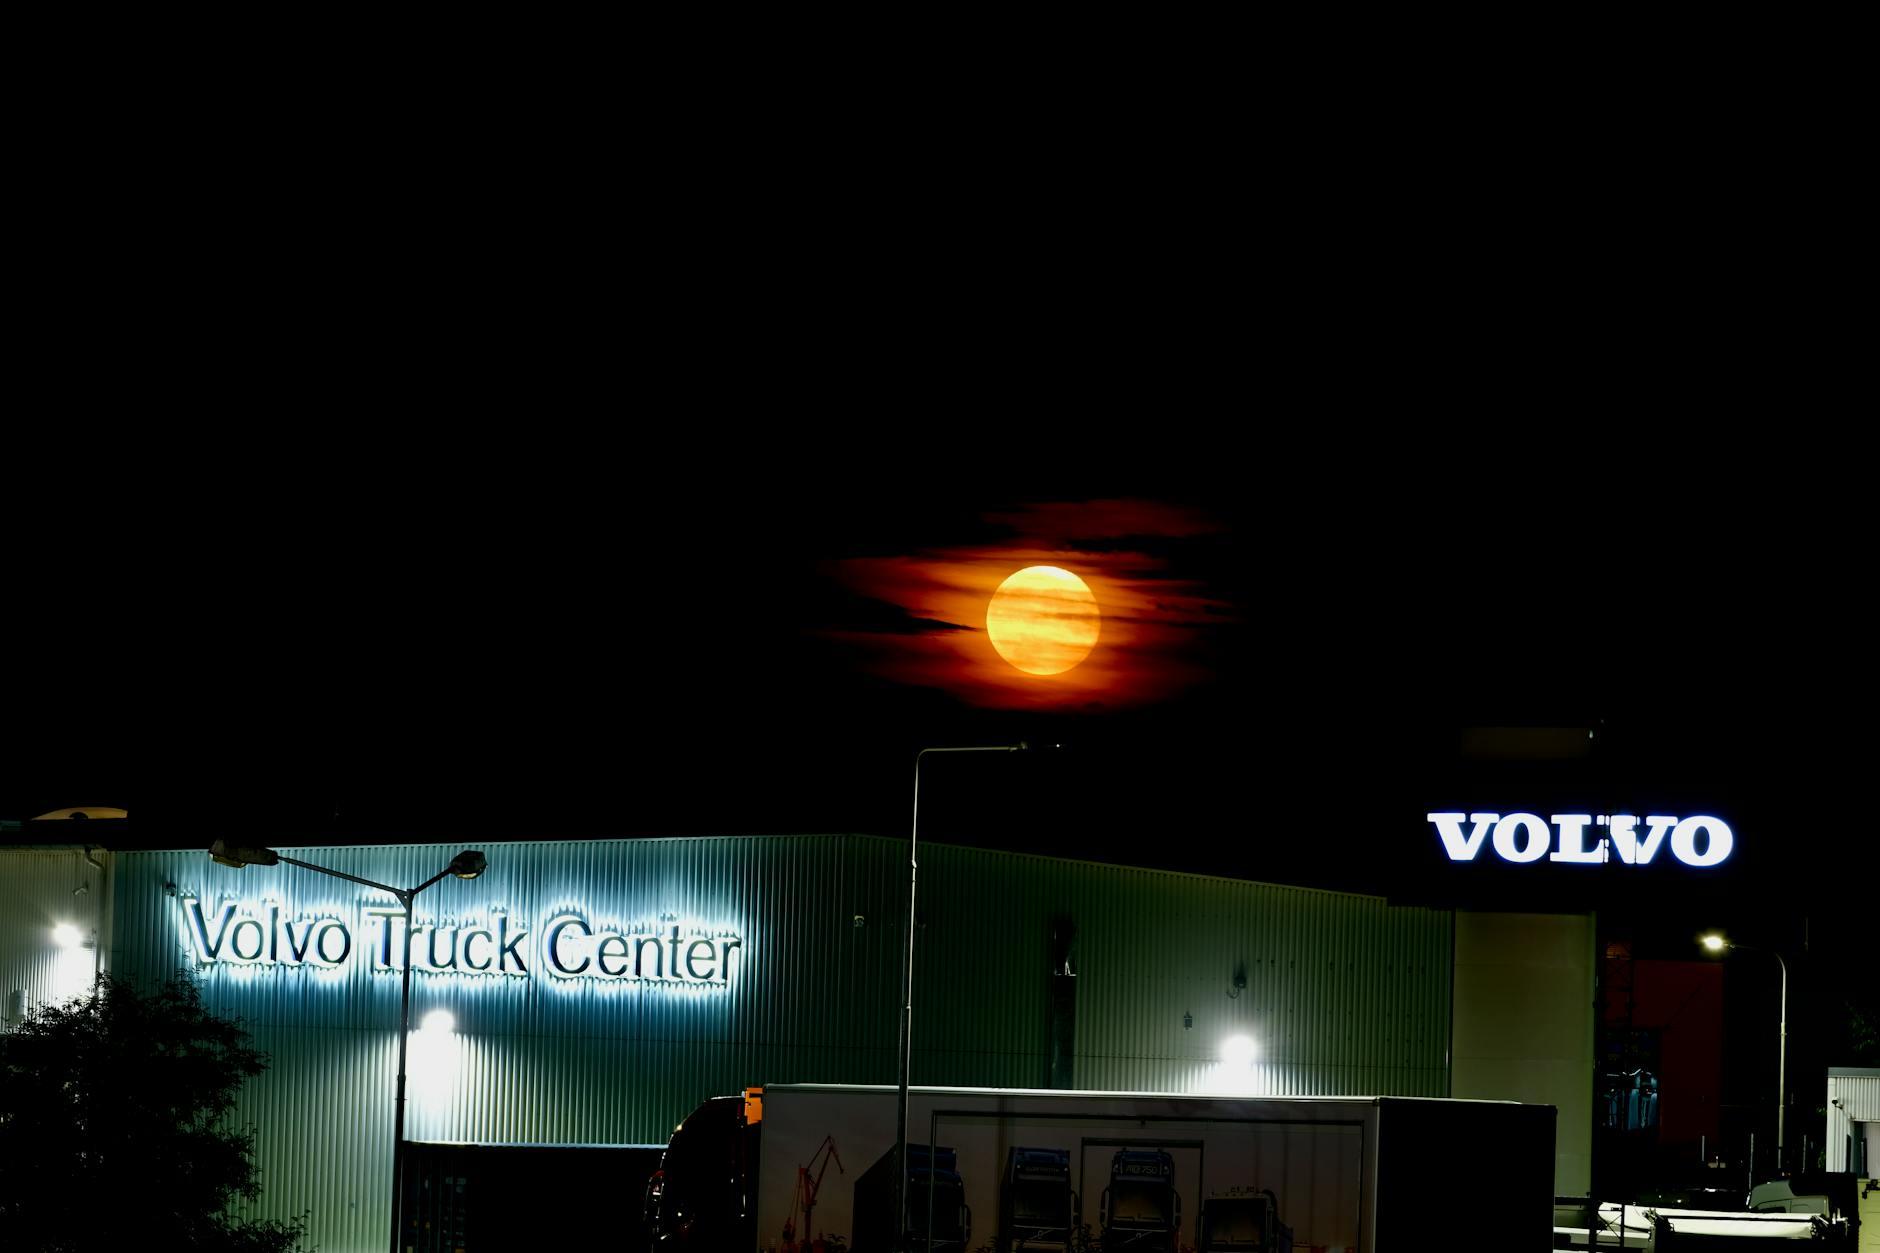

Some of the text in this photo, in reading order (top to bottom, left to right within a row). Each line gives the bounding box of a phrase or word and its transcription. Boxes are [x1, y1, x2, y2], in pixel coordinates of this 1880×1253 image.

[1427, 812, 1734, 867] VOLVO
[187, 900, 351, 966] Volvo
[543, 915, 742, 984] Center
